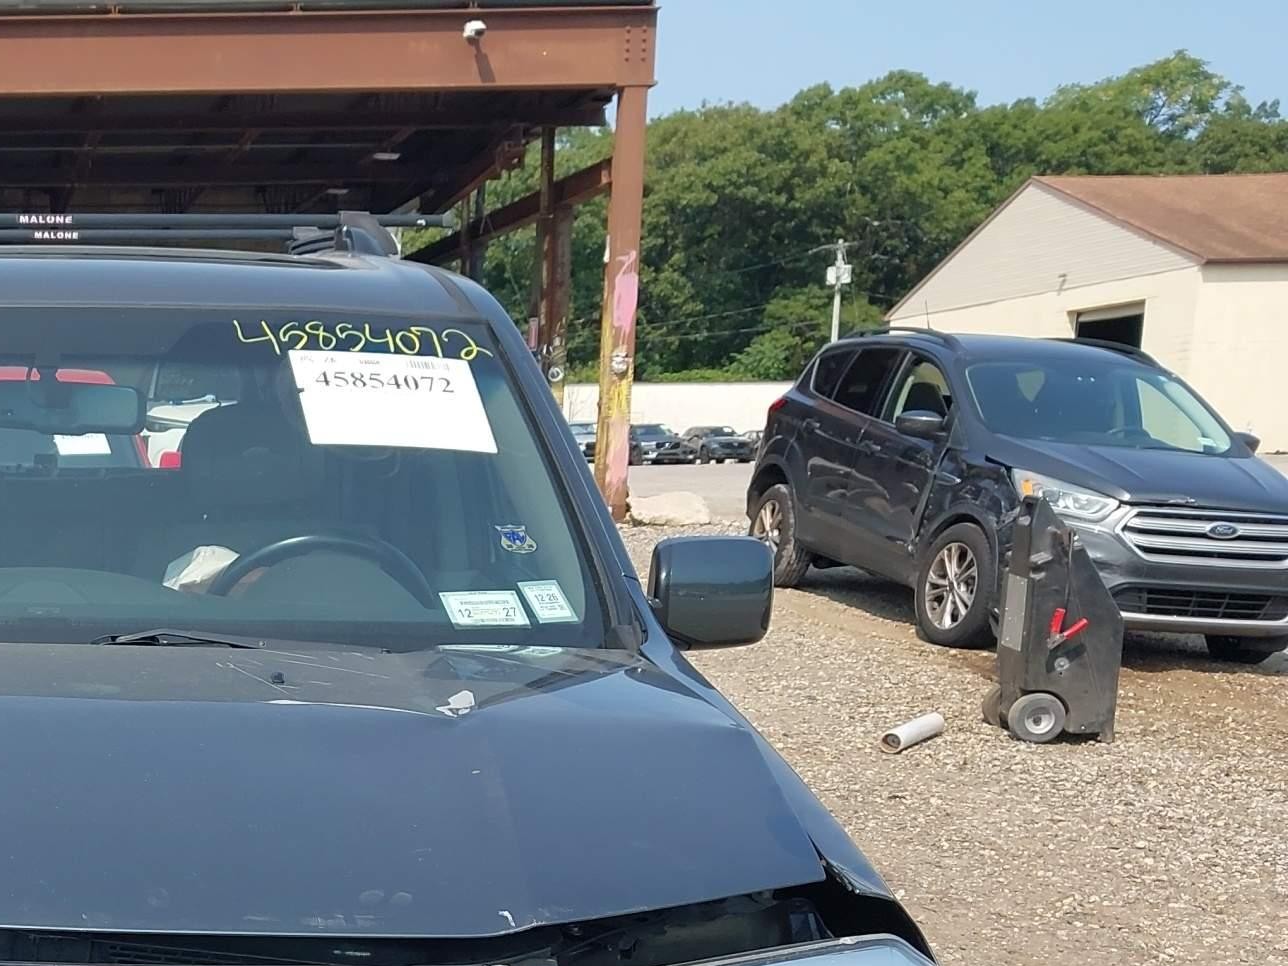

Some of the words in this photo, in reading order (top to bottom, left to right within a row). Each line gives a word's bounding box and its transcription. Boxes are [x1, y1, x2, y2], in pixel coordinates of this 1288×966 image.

[19, 215, 73, 224] MALONE
[34, 231, 79, 240] MALONE
[233, 319, 495, 360] 45854072
[315, 370, 455, 394] 45854072
[458, 608, 474, 618] 12
[503, 607, 517, 617] 27
